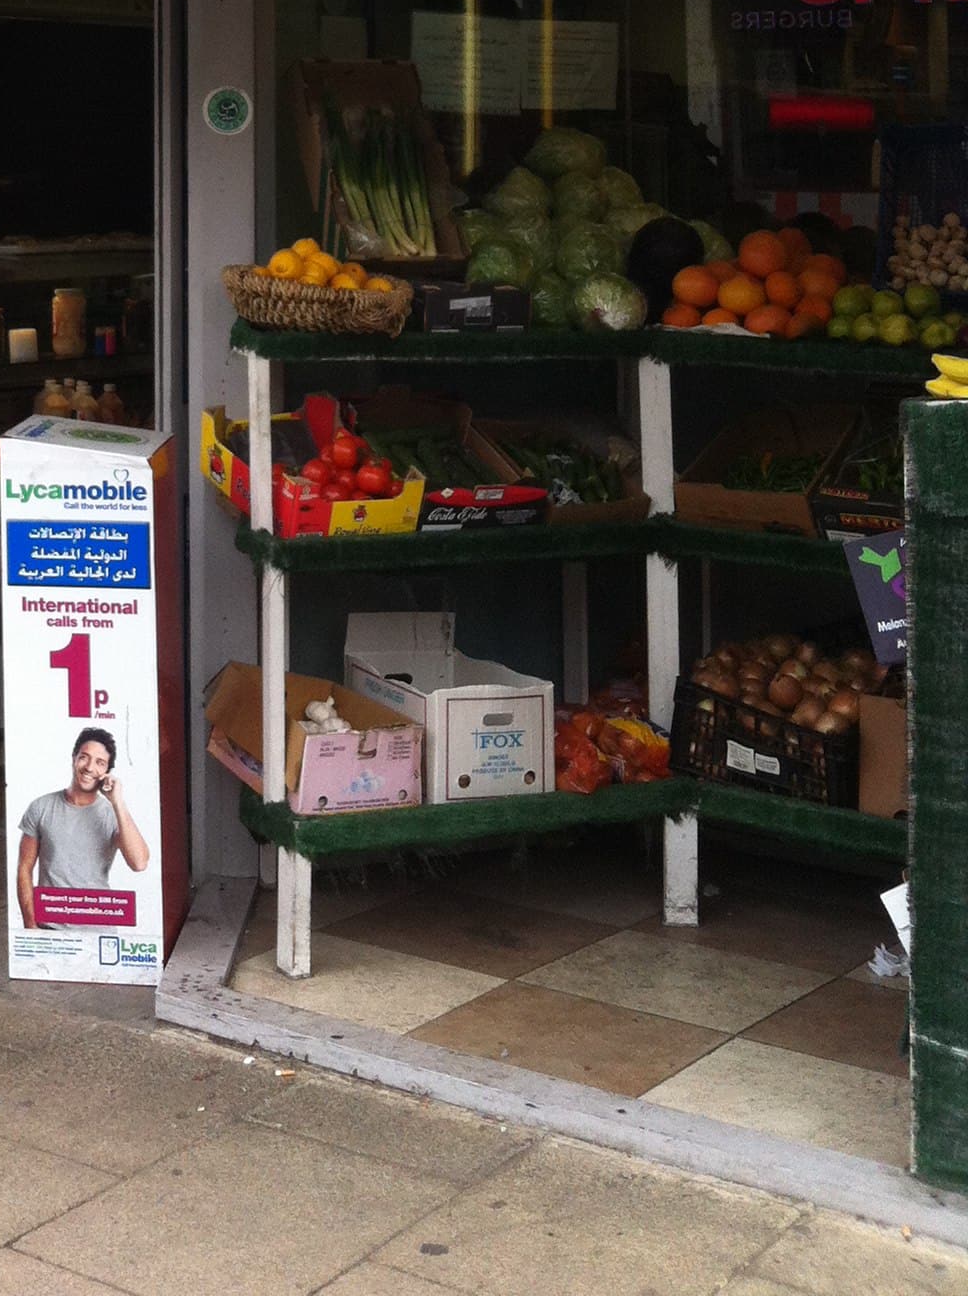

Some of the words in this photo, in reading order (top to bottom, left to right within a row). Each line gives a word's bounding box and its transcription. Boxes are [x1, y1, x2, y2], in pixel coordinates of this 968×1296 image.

[6, 478, 148, 503] Lycamobile
[22, 596, 138, 615] International
[47, 615, 78, 628] calls
[82, 615, 114, 628] from
[49, 633, 92, 718] 1
[94, 689, 109, 709] p
[479, 733, 524, 750] FOX
[121, 938, 158, 955] Lyca
[121, 953, 158, 964] mobile
